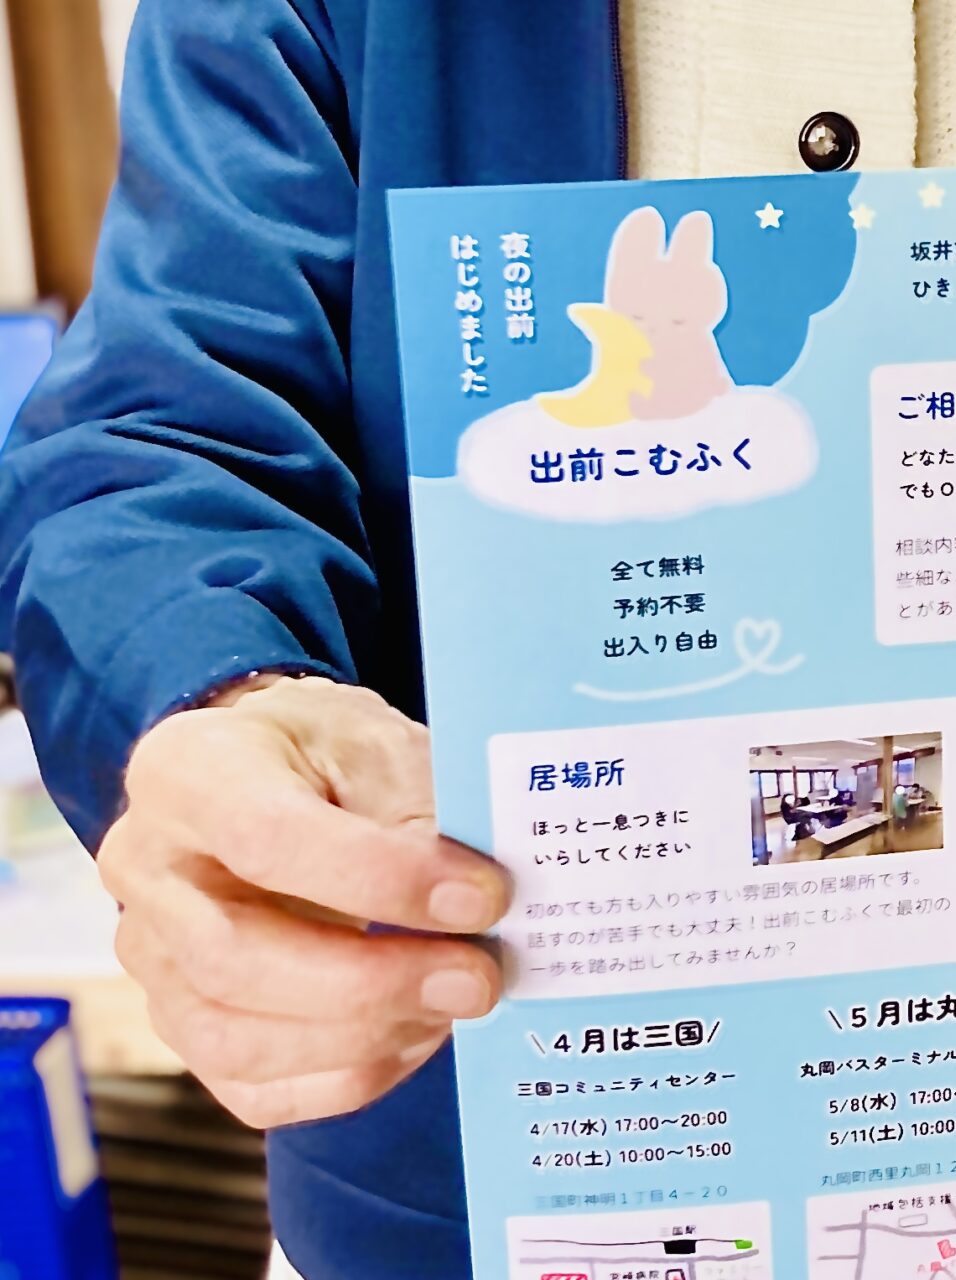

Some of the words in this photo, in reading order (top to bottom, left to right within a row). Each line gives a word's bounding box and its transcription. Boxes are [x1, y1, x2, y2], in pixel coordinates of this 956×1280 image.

[501, 232, 535, 339] 夜の出前
[450, 235, 488, 393] はじめました
[530, 438, 752, 483] 出前こむふく
[611, 554, 705, 581] 全て無料
[614, 592, 706, 619] 予約不要
[604, 629, 718, 658] 出入り自由
[529, 758, 625, 792] 居場所
[532, 809, 690, 837] ほっと一息つきに
[534, 841, 692, 867] いらしてください
[517, 1071, 736, 1097] 三国コミュニティセンター
